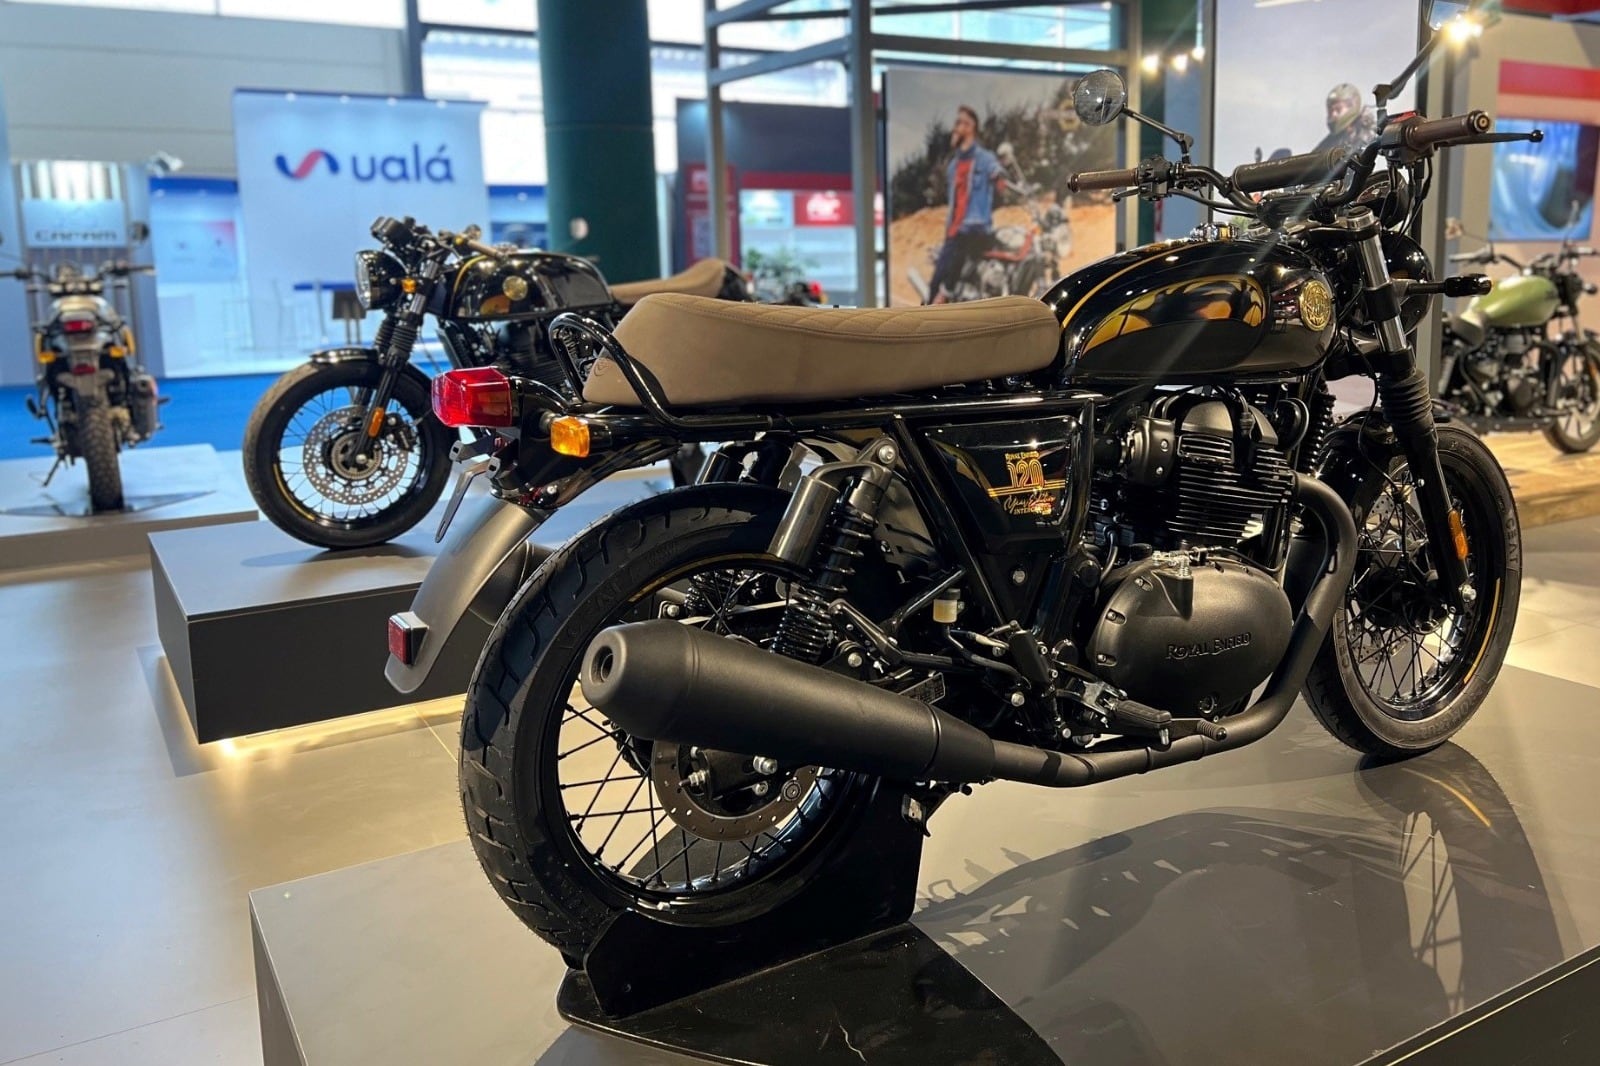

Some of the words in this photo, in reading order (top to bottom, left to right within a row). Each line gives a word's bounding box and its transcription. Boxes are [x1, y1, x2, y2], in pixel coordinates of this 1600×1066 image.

[351, 142, 454, 183] ualá
[1006, 458, 1044, 488] 120
[1505, 518, 1519, 564] CEAT
[1165, 642, 1209, 660] ROYAL
[1211, 631, 1252, 656] ENFIELD
